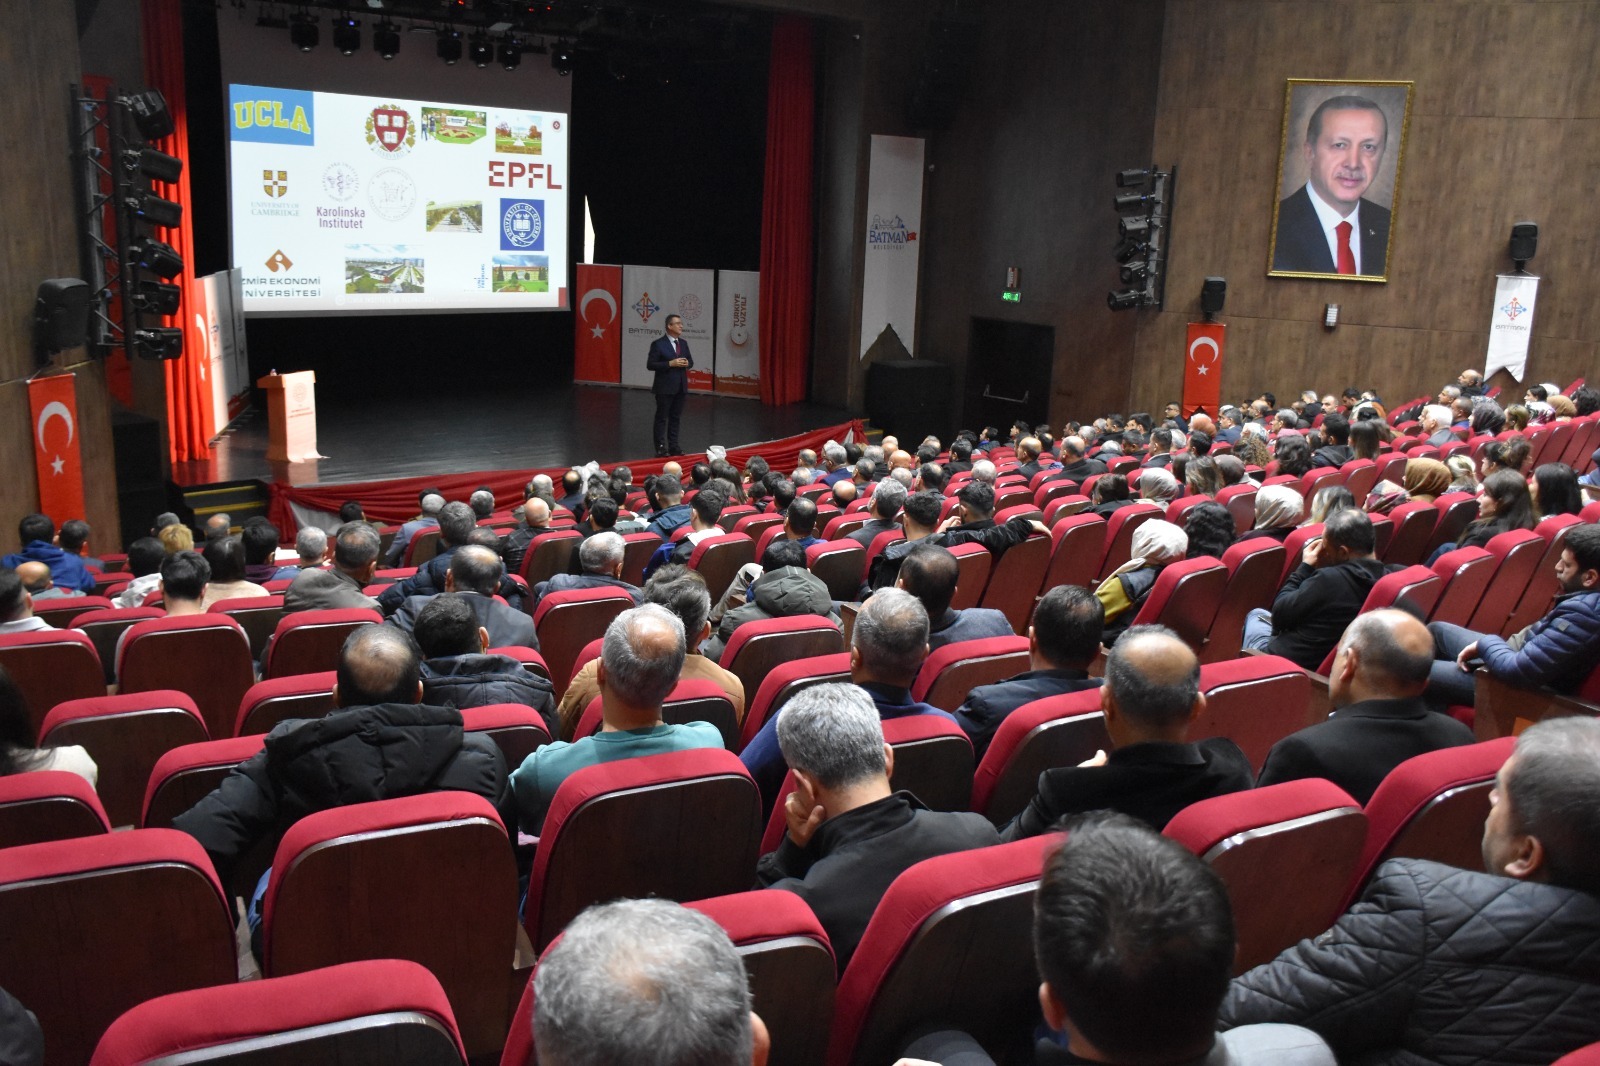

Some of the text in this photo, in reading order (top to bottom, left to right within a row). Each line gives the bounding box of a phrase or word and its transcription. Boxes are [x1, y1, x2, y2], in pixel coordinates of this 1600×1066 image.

[233, 100, 311, 135] UCLA
[489, 160, 562, 190] EPFL
[251, 208, 300, 217] CAMBRIDGE
[316, 206, 366, 218] Karolinska
[319, 218, 363, 229] Institutet
[869, 230, 909, 243] BATMAN
[242, 276, 321, 285] ZMİR EKONOMİ
[242, 288, 321, 297] NİVERSİTESİ
[628, 327, 663, 336] BATMAN
